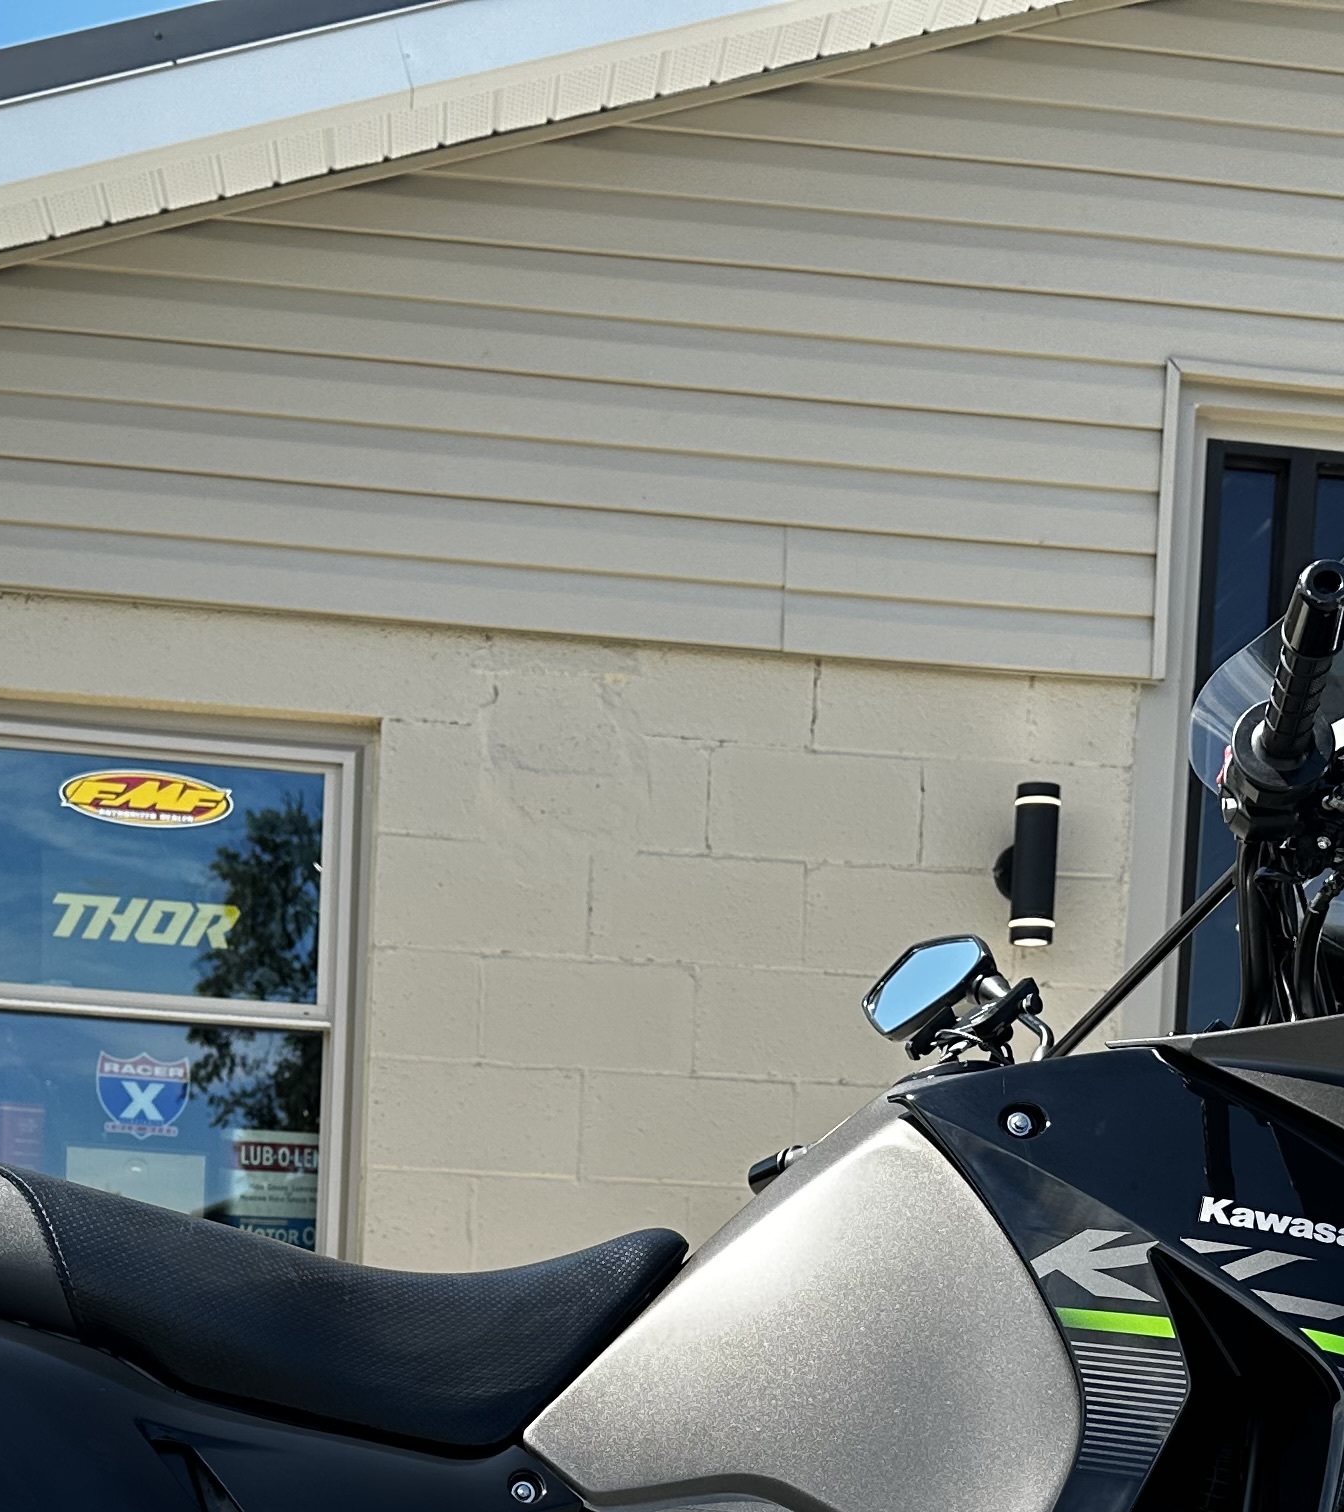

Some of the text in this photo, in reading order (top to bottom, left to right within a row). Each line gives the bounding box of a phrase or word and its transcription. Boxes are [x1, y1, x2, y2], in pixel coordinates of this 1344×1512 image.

[68, 781, 225, 812] FMF
[52, 892, 241, 949] THOR
[103, 1062, 184, 1078] RACER
[120, 1081, 165, 1121] X
